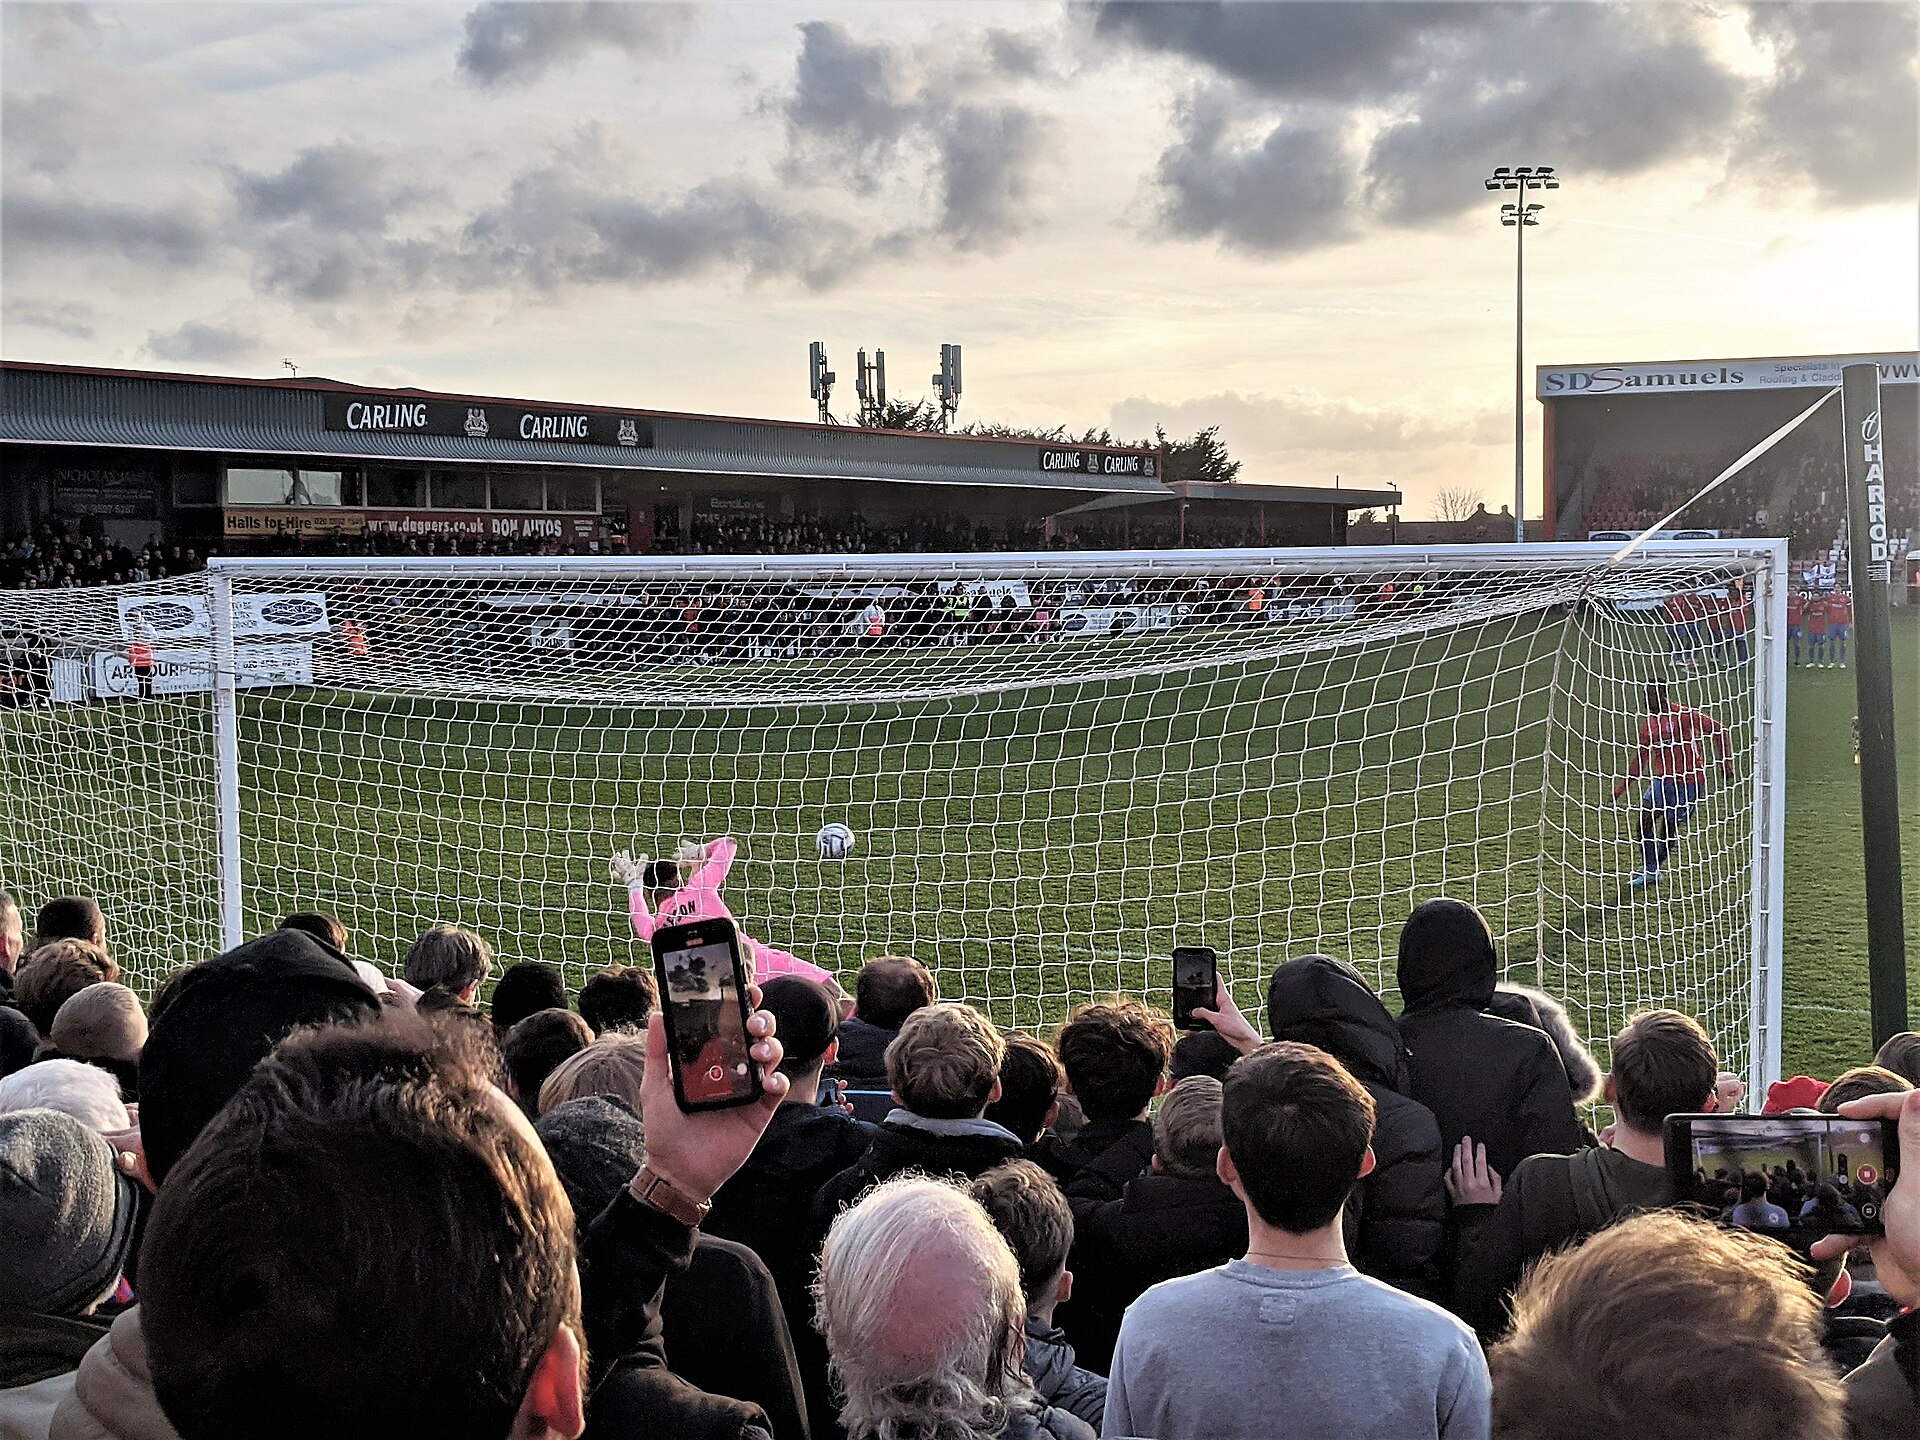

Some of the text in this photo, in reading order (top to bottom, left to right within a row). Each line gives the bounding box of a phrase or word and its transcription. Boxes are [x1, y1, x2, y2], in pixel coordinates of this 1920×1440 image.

[1774, 361, 1840, 373] Specialists in
[1759, 373, 1798, 385] Roofing
[1801, 374, 1808, 383] &
[346, 402, 428, 430] CARLING
[519, 413, 588, 440] CARLING
[1043, 451, 1080, 470] CARLING
[1104, 455, 1139, 474] CARLING
[1863, 443, 1888, 562] HARROD
[227, 516, 260, 529] Halls
[265, 516, 281, 529] for
[286, 517, 312, 529] Hire
[522, 519, 562, 538] AUTOS
